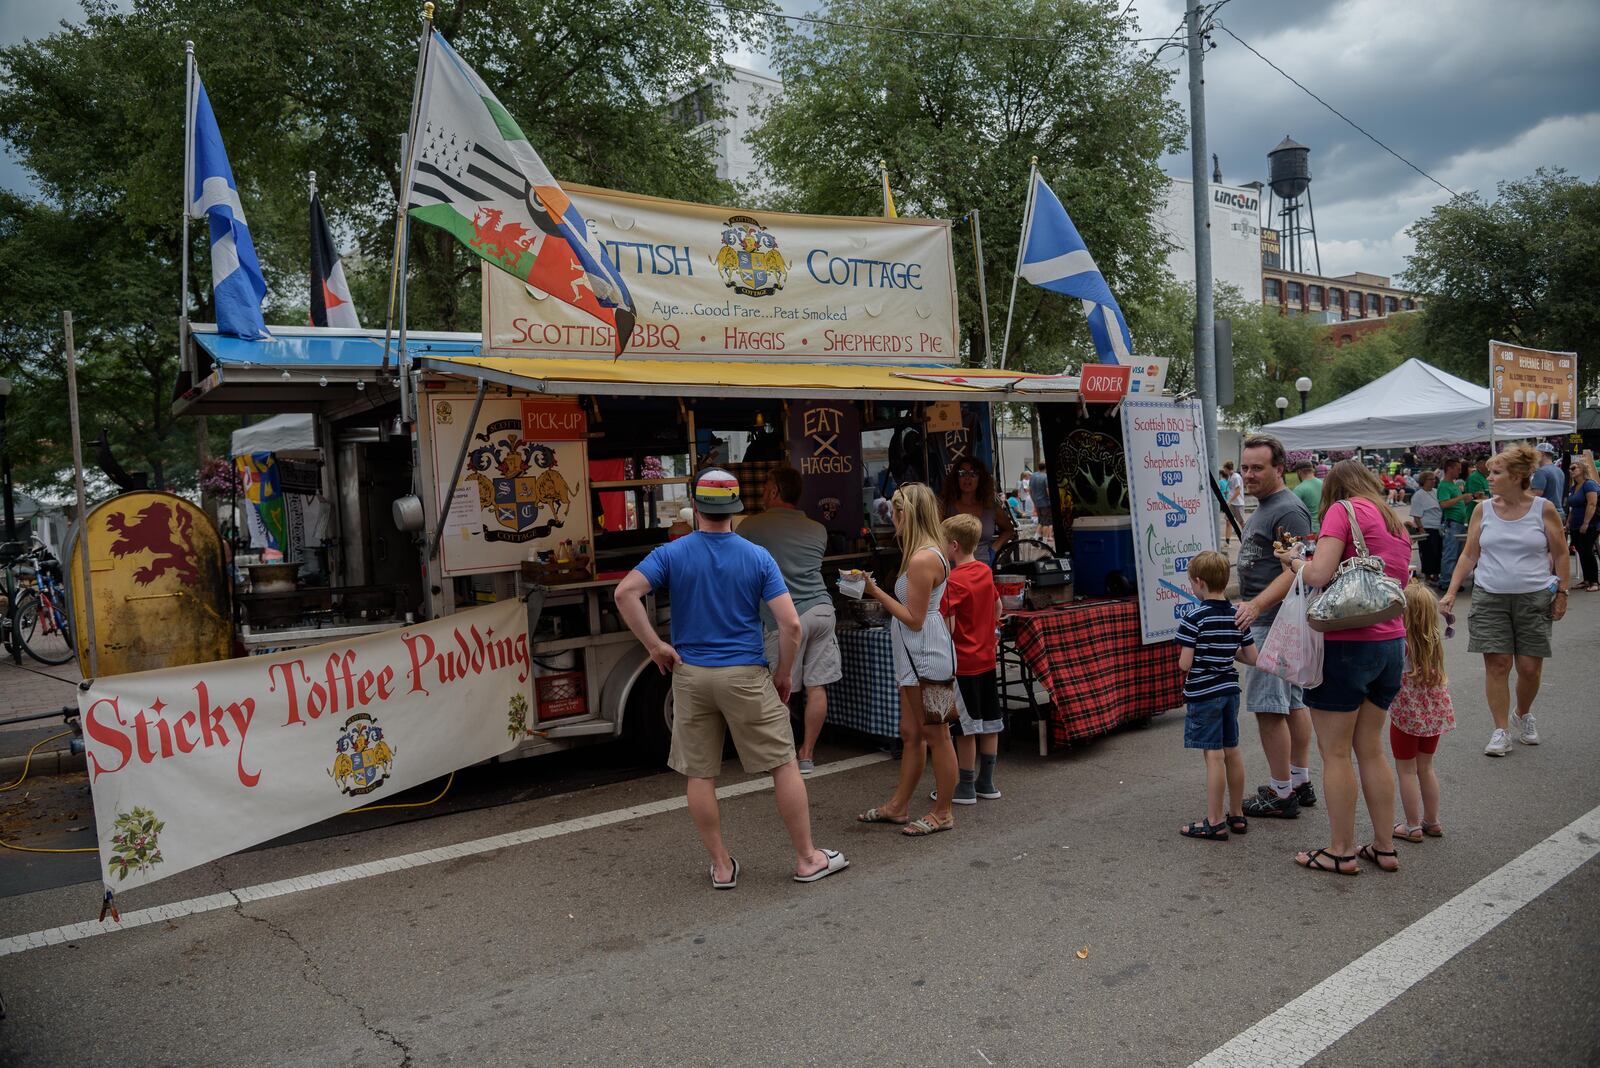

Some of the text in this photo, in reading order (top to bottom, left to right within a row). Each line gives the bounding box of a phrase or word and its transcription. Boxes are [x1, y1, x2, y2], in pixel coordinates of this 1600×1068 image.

[1261, 230, 1277, 241] SON
[598, 239, 693, 276] TTISH
[801, 305, 848, 321] Smoked
[631, 323, 681, 350] BBQ
[724, 327, 785, 350] HAGGIS
[823, 329, 913, 353] SHEPHERD'S
[919, 332, 942, 353] PIE
[1132, 366, 1145, 375] VISA
[1086, 375, 1123, 392] ORDER
[489, 420, 522, 432] SCOTTI
[527, 412, 582, 430] PICK-UP
[803, 407, 844, 438] EAT
[1134, 412, 1166, 431] Scottish
[1167, 418, 1185, 432] BBQ
[944, 427, 970, 449] EAT
[1157, 433, 1179, 446] $10.00
[801, 456, 852, 475] HAGGIS
[1143, 450, 1196, 476] Shepherd's Pie
[1162, 472, 1182, 485] $8.00
[1167, 512, 1186, 526] $9.00
[497, 528, 537, 542] COTTAGE
[1154, 534, 1202, 556] Celtic Combo
[84, 624, 530, 787] Sticky Toffee Pudding
